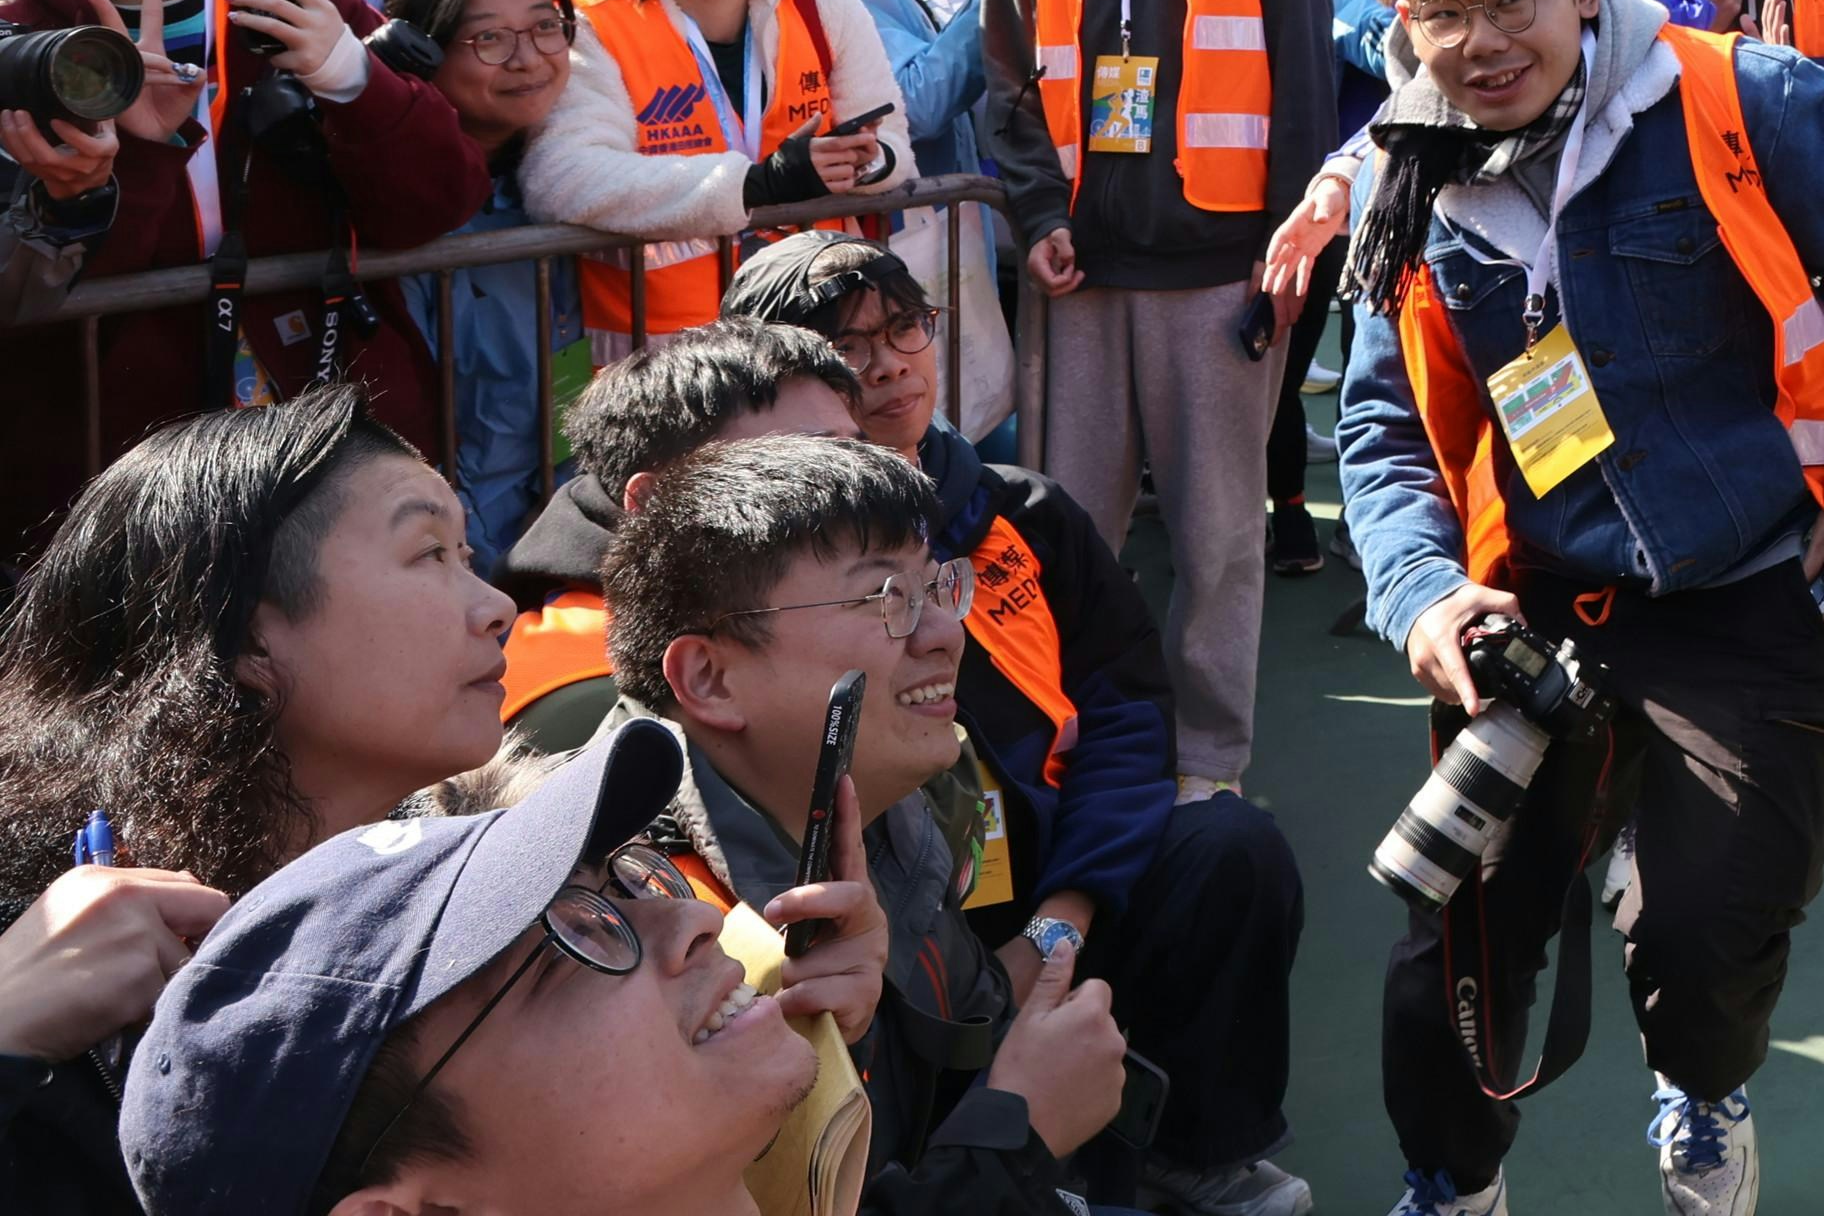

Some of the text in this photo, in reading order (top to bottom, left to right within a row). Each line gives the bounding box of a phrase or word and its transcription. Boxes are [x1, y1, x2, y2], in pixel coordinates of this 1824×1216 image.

[799, 71, 821, 95] 傳
[788, 98, 830, 122] MED
[647, 124, 704, 141] HKAAA
[317, 312, 339, 382] SONY
[987, 578, 1037, 626] MED
